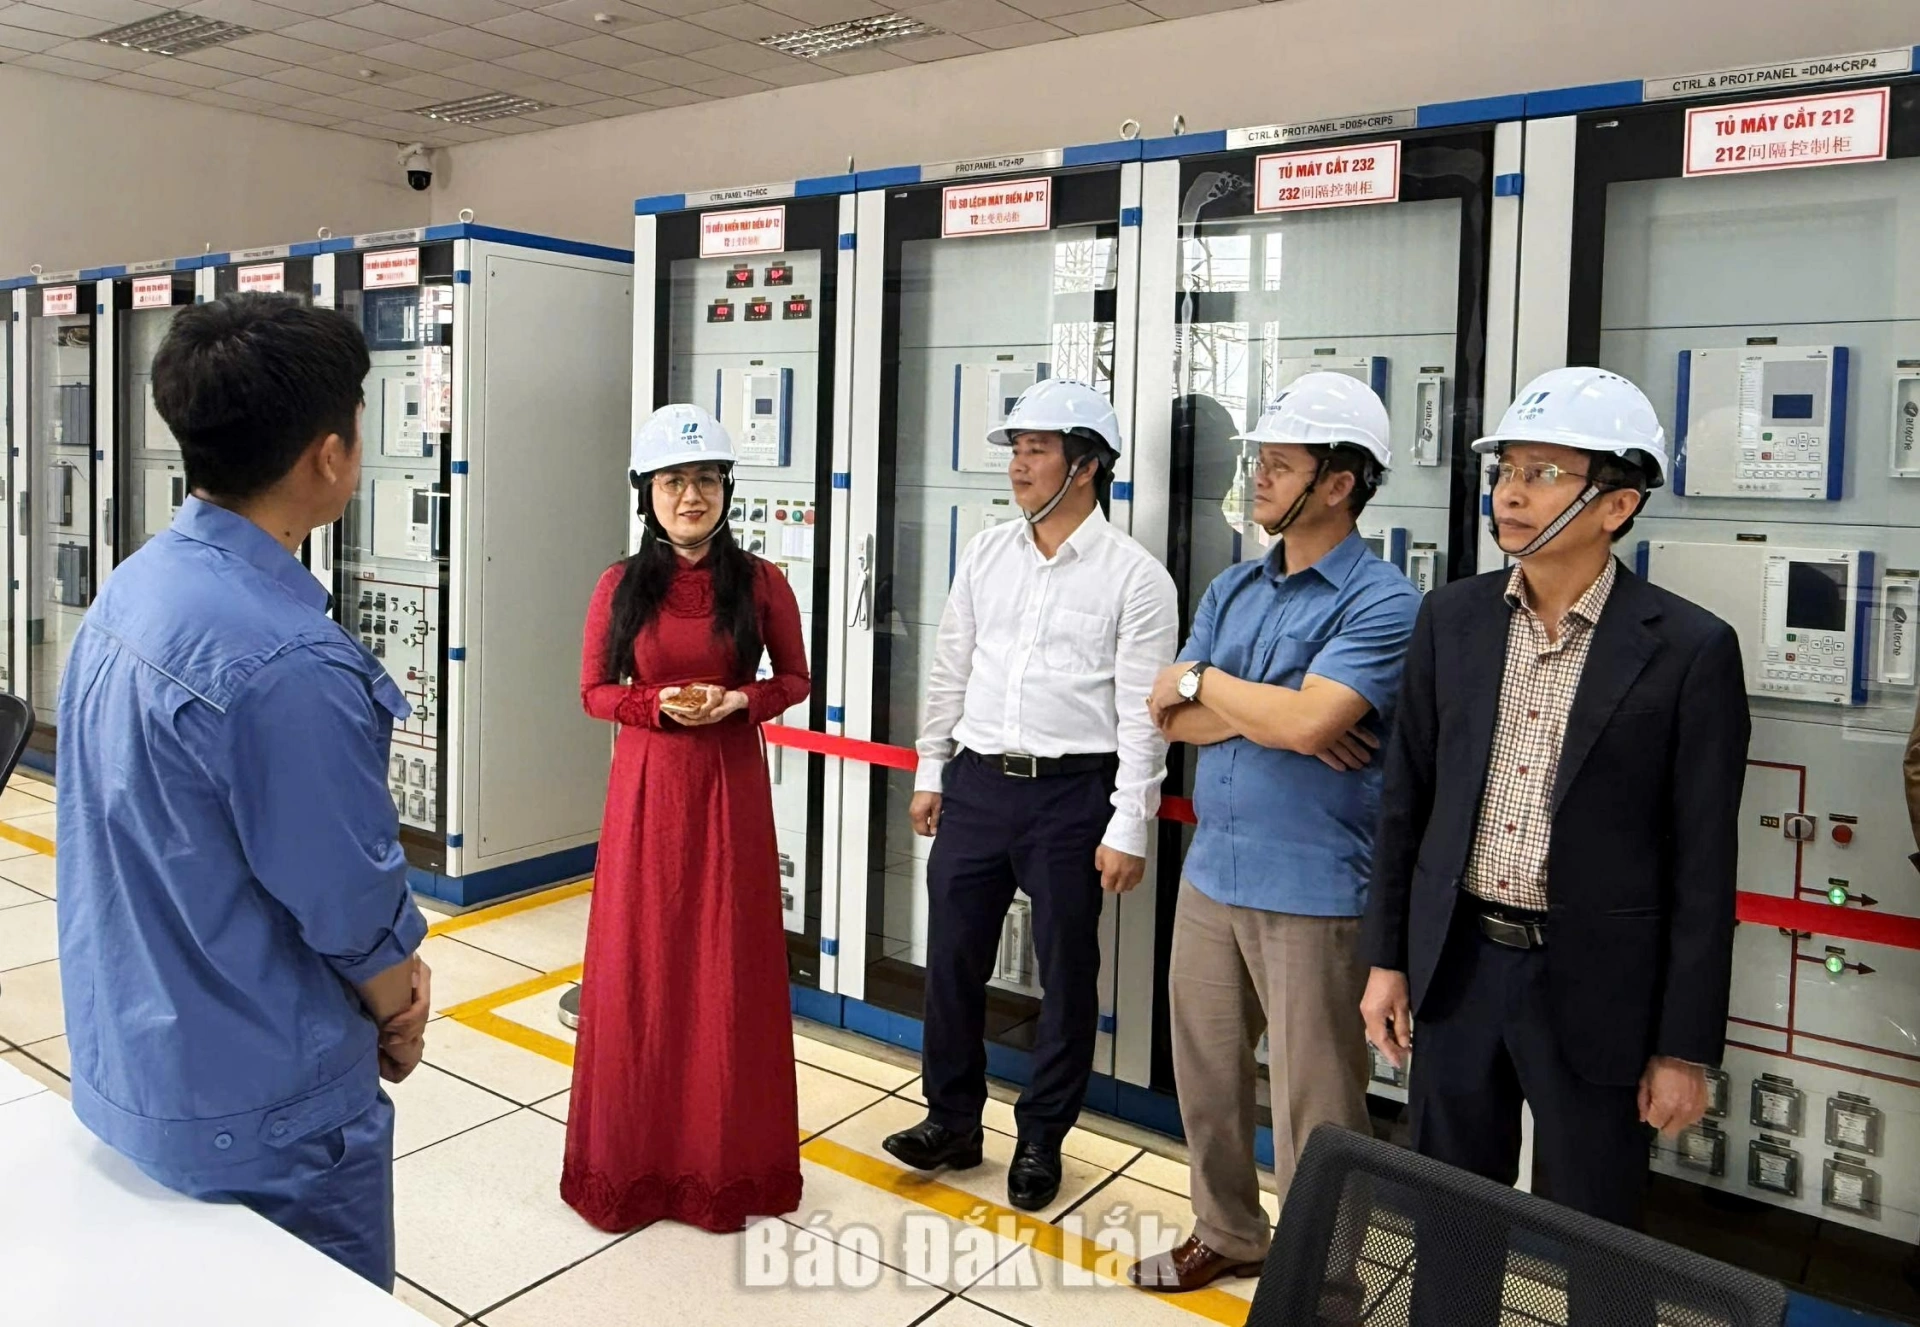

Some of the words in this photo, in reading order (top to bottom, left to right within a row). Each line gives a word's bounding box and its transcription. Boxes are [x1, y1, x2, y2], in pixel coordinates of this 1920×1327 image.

[1715, 115, 1735, 136] TỦ
[1741, 114, 1778, 134] MÁY
[1784, 107, 1817, 129] CẮT
[1822, 108, 1854, 126] 212
[1279, 162, 1293, 179] TỦ
[1296, 161, 1322, 177] MÁY
[1326, 156, 1349, 175] CẮT
[1352, 157, 1375, 172] 232
[1036, 191, 1044, 202] T2
